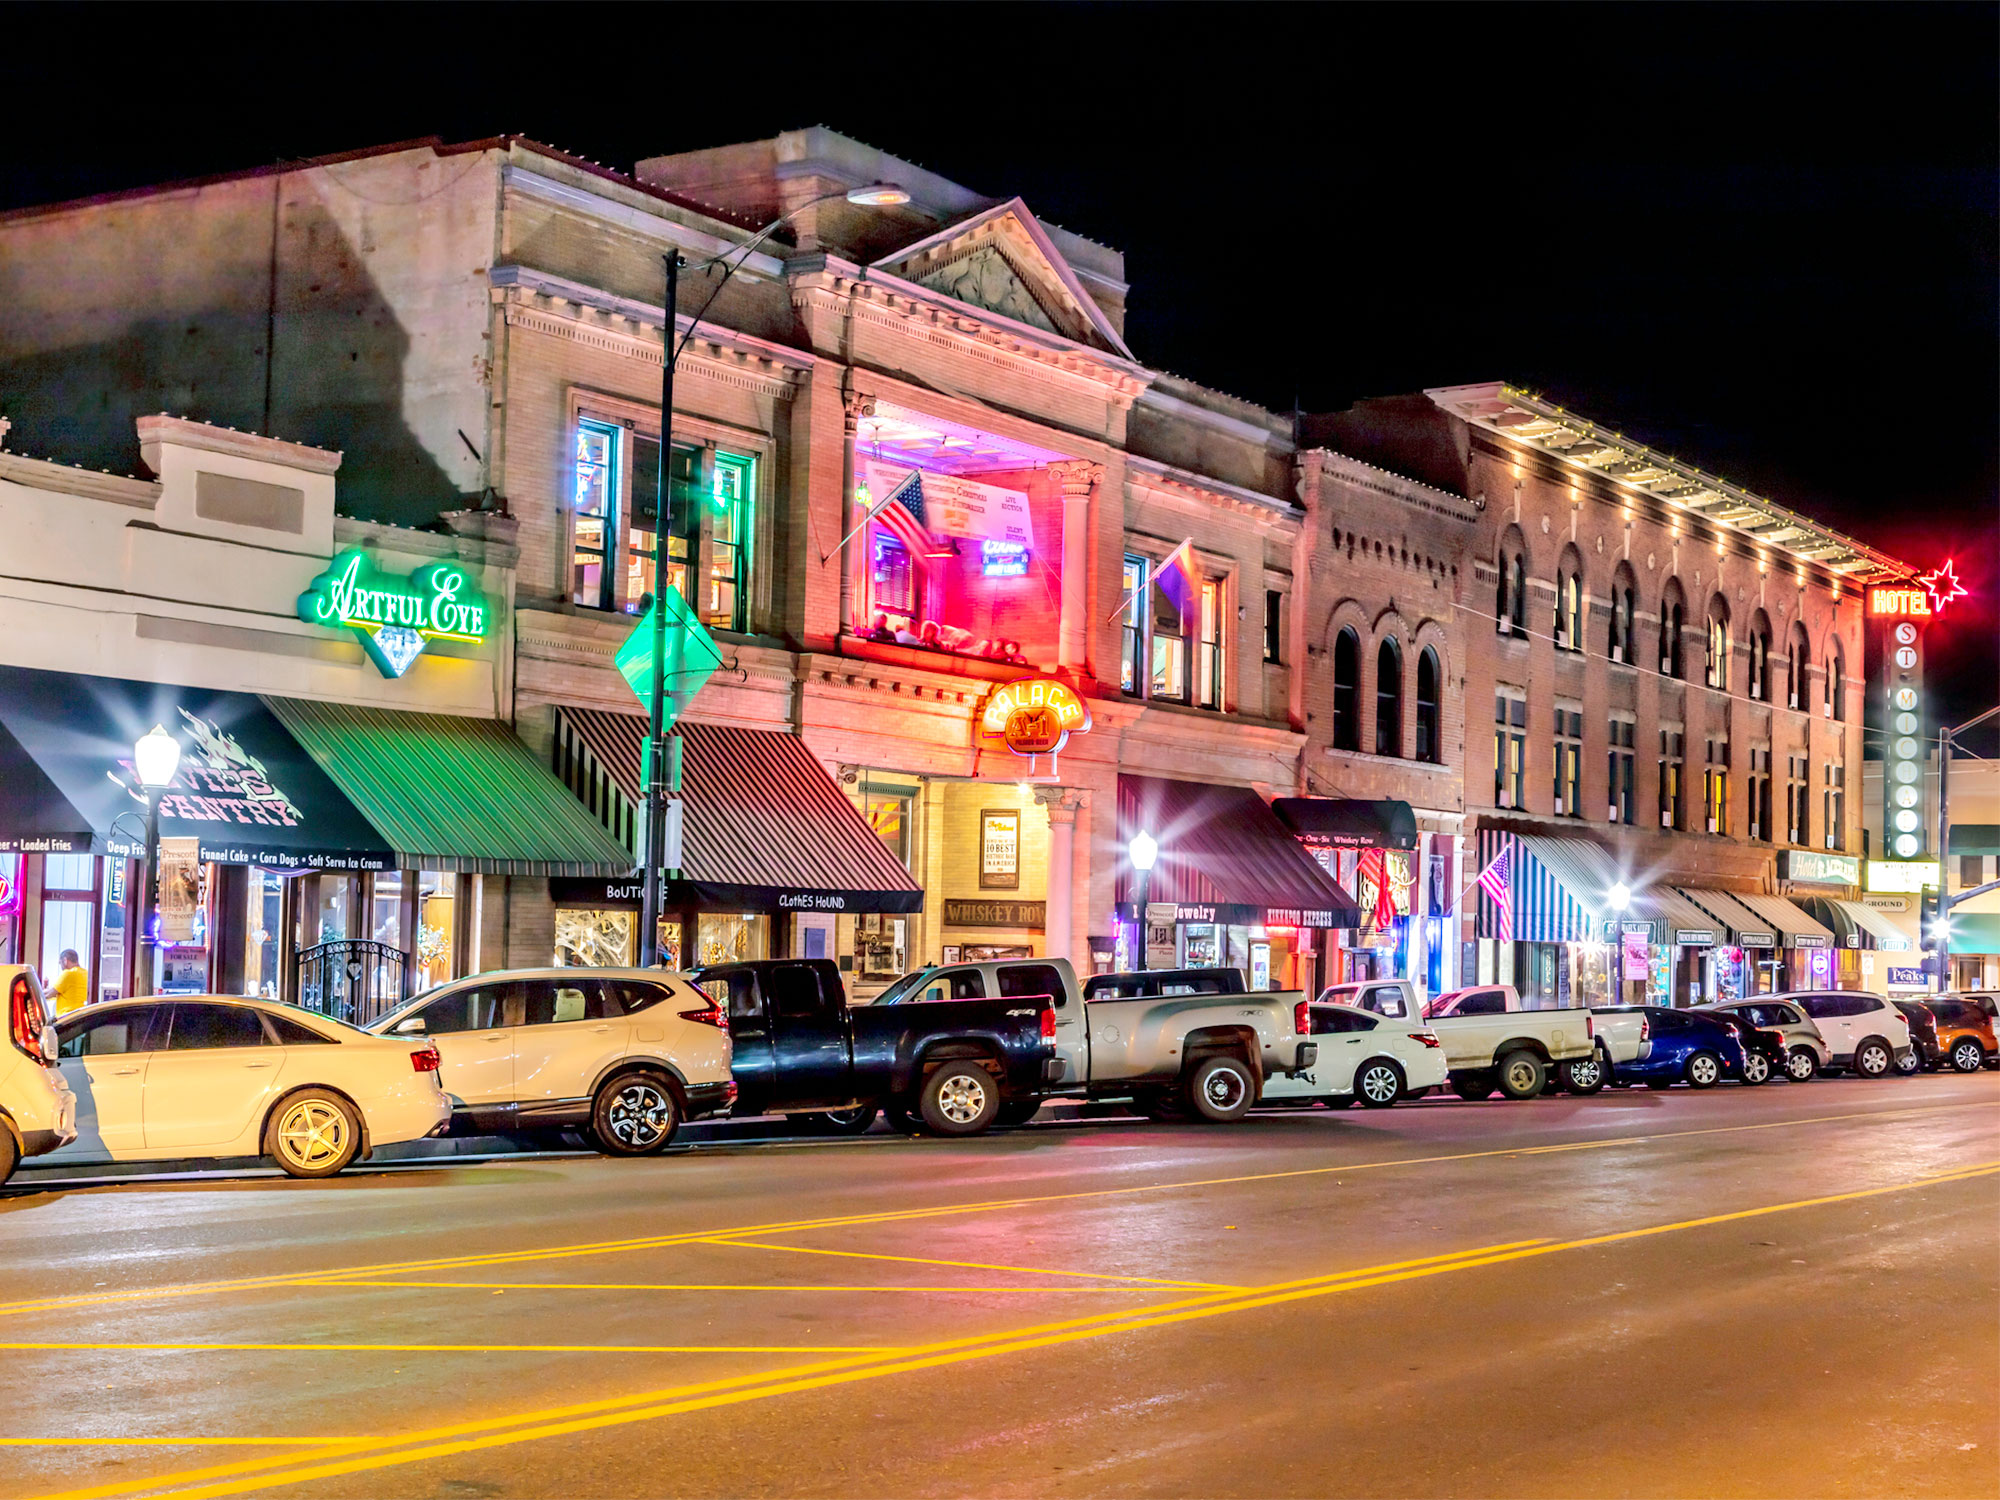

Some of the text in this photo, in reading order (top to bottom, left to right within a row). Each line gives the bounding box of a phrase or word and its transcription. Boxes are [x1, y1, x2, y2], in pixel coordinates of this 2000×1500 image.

[316, 553, 483, 635] ARTFUL EYE
[1873, 589, 1931, 615] HOTEL
[985, 684, 1080, 726] PALACE
[20, 838, 50, 851] Loaded
[51, 838, 72, 851] Fries
[996, 843, 1015, 853] BEST
[107, 840, 130, 857] Deep
[200, 847, 228, 861] Funnel
[229, 849, 249, 862] Cake
[259, 852, 277, 864] Corn
[279, 853, 298, 868] Dogs
[308, 855, 324, 867] Soft
[325, 856, 346, 868] Serve
[347, 857, 358, 869] Ice
[360, 857, 383, 869] Cream
[947, 904, 1014, 922] WHISKEY
[1303, 910, 1333, 927] EXPRESS
[1893, 969, 1925, 981] Peaks
